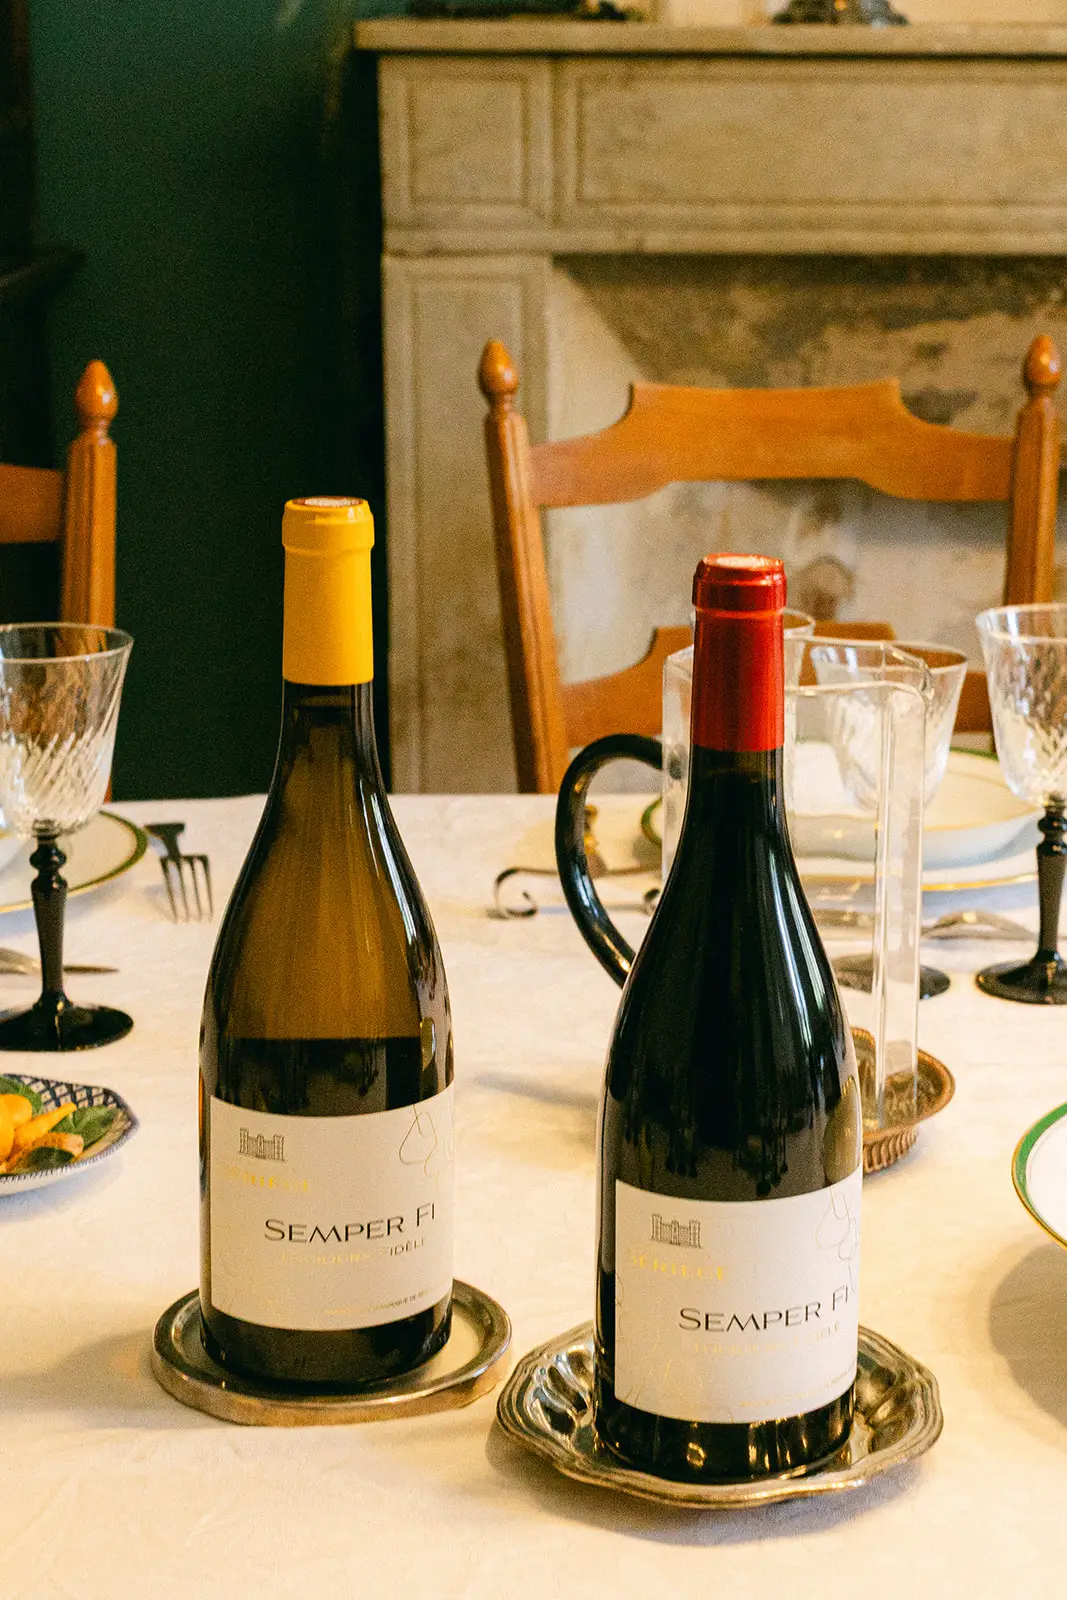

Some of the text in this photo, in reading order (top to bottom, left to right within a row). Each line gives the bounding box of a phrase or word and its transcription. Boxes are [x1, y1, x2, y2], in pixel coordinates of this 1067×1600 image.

[264, 1202, 435, 1244] SEMPER FI
[679, 1301, 822, 1333] SEMPER
